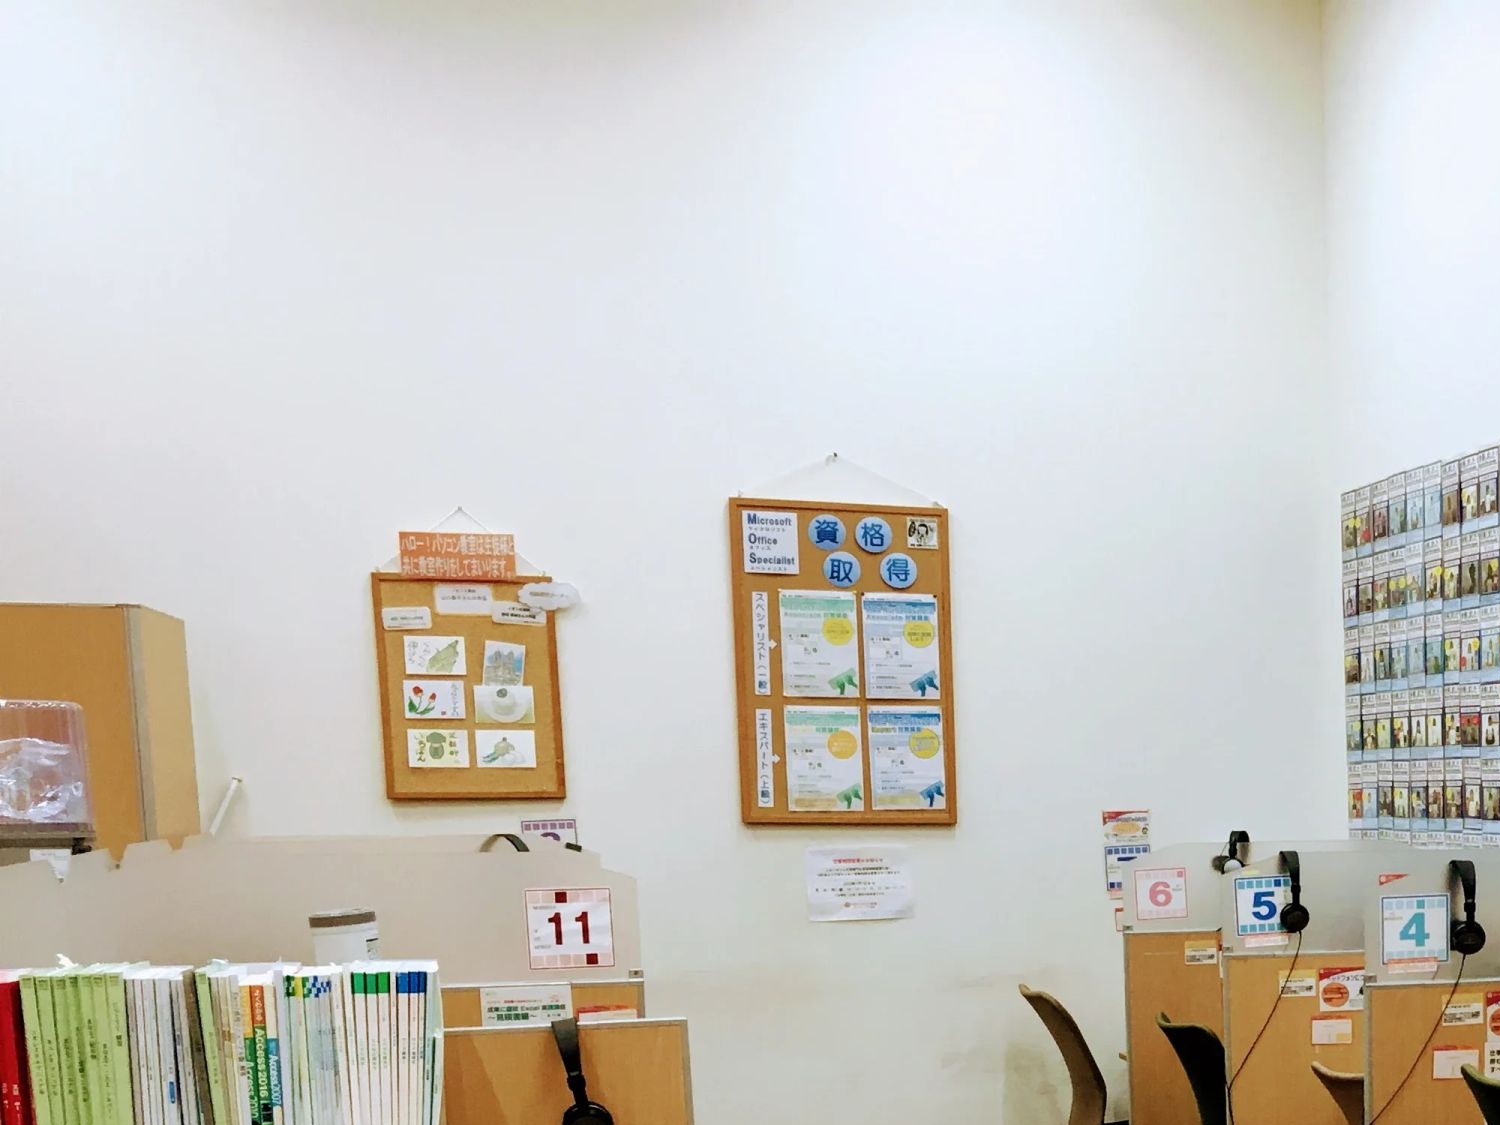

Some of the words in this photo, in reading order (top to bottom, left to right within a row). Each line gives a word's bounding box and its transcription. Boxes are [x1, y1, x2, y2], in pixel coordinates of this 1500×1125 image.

[747, 513, 792, 526] Microsoft
[748, 533, 778, 545] Office
[749, 552, 795, 565] Specialist
[1148, 881, 1173, 907] 6
[1251, 891, 1277, 921] 5
[548, 911, 590, 945] 11
[1399, 912, 1430, 947] 4
[254, 1028, 266, 1071] Access
[258, 1071, 268, 1097] 2016
